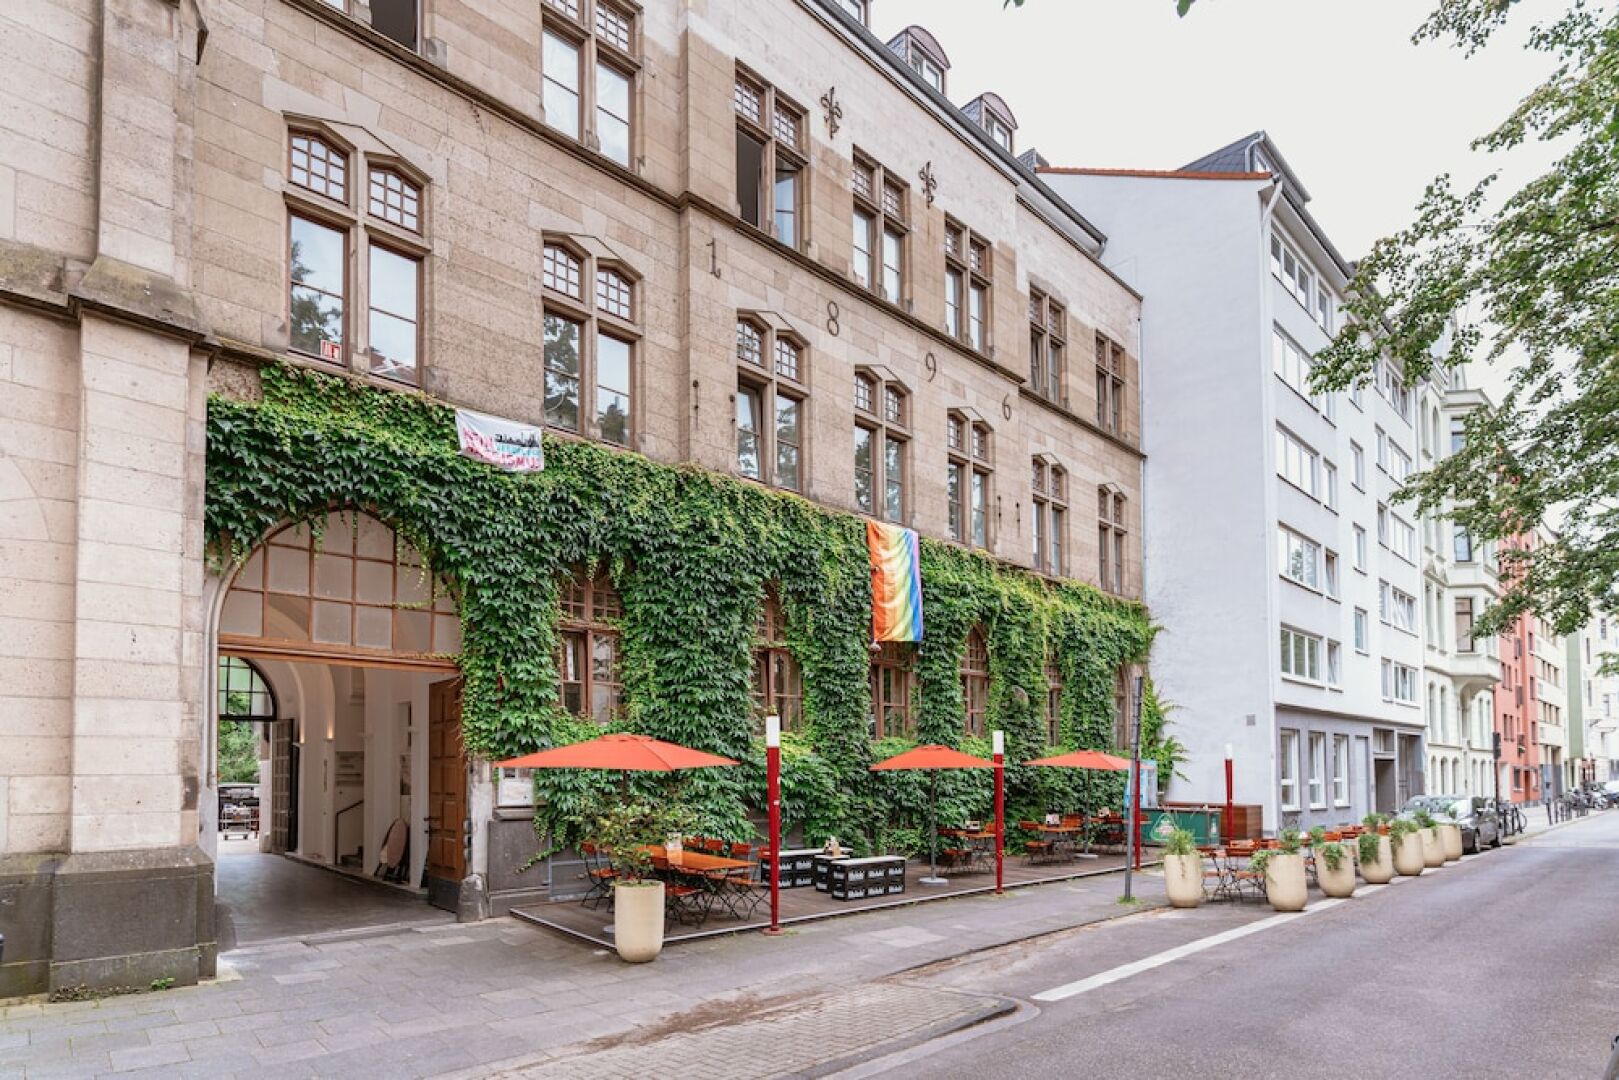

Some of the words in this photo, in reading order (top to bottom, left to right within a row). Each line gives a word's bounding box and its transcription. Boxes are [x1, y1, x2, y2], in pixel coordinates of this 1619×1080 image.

[706, 238, 721, 279] 1
[827, 301, 839, 337] 8
[925, 351, 936, 383] 9
[1002, 392, 1012, 421] 6
